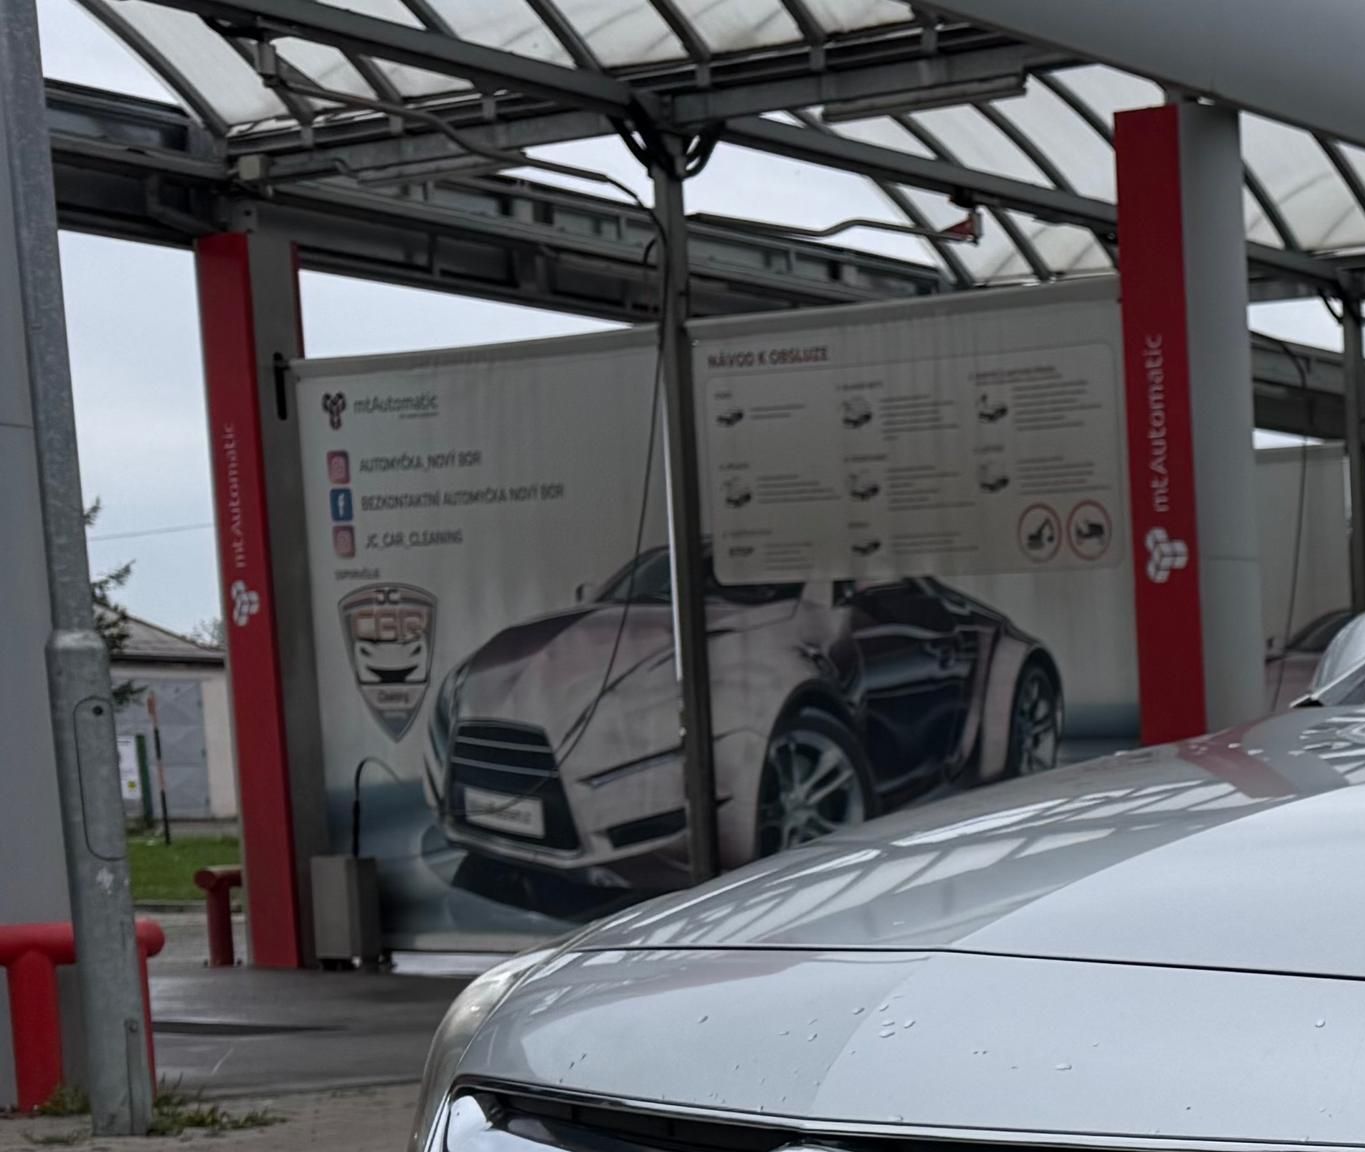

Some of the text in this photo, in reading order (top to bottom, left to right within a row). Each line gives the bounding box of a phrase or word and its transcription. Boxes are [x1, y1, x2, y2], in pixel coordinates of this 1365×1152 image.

[353, 394, 438, 414] mtAutomatic
[1143, 333, 1169, 512] mtAutomatic
[224, 422, 247, 568] mtAutomatic
